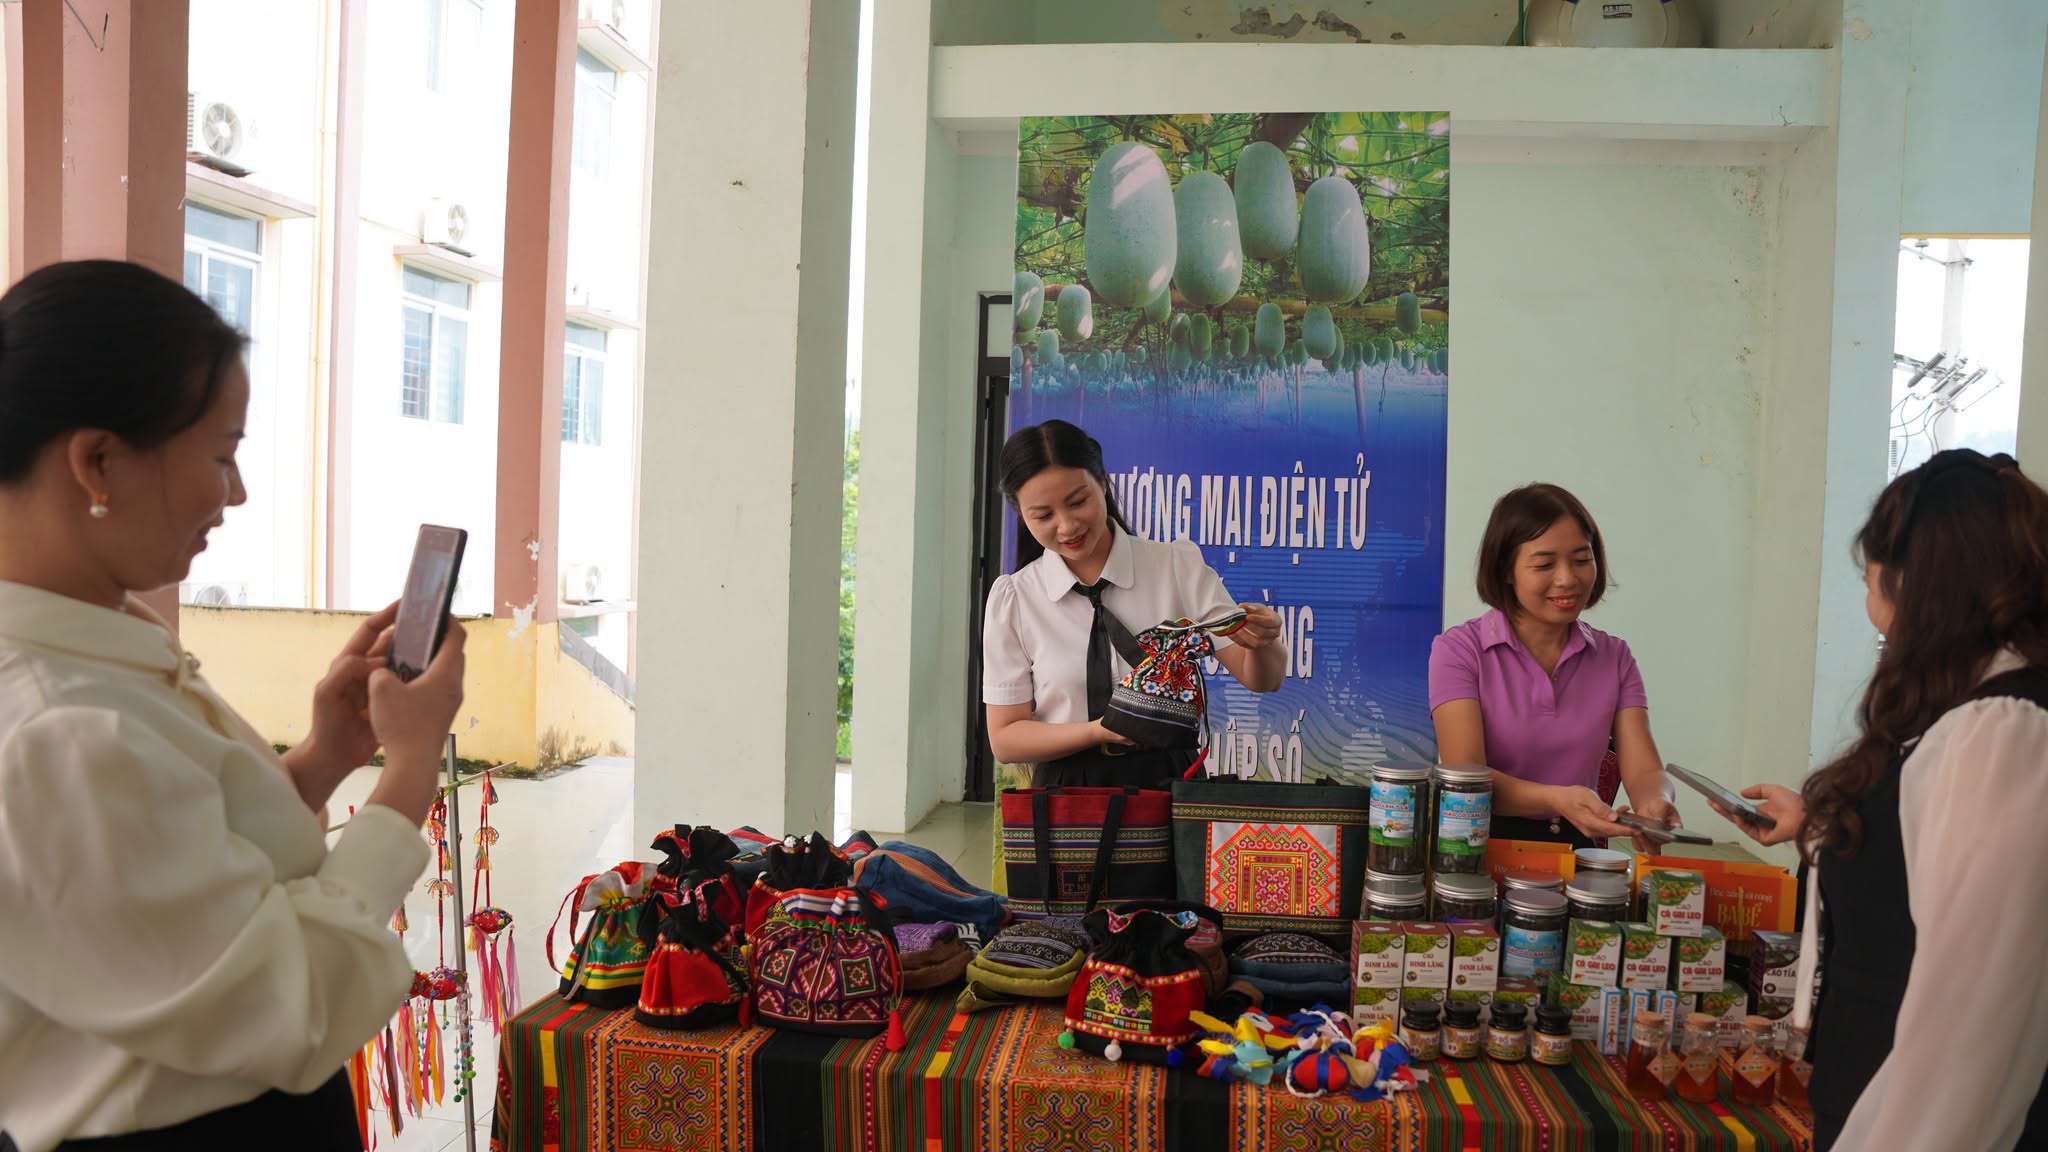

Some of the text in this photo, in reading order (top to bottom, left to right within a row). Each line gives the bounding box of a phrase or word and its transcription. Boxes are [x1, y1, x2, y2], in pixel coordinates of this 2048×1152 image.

[1200, 475, 1253, 563] MẠI
[1260, 461, 1326, 564] ĐIỆN
[1334, 453, 1371, 551] TỬ
[1268, 709, 1305, 783] SỐ
[1687, 911, 1701, 920] LEO
[1601, 962, 1616, 971] LEO
[1652, 965, 1666, 973] LEO
